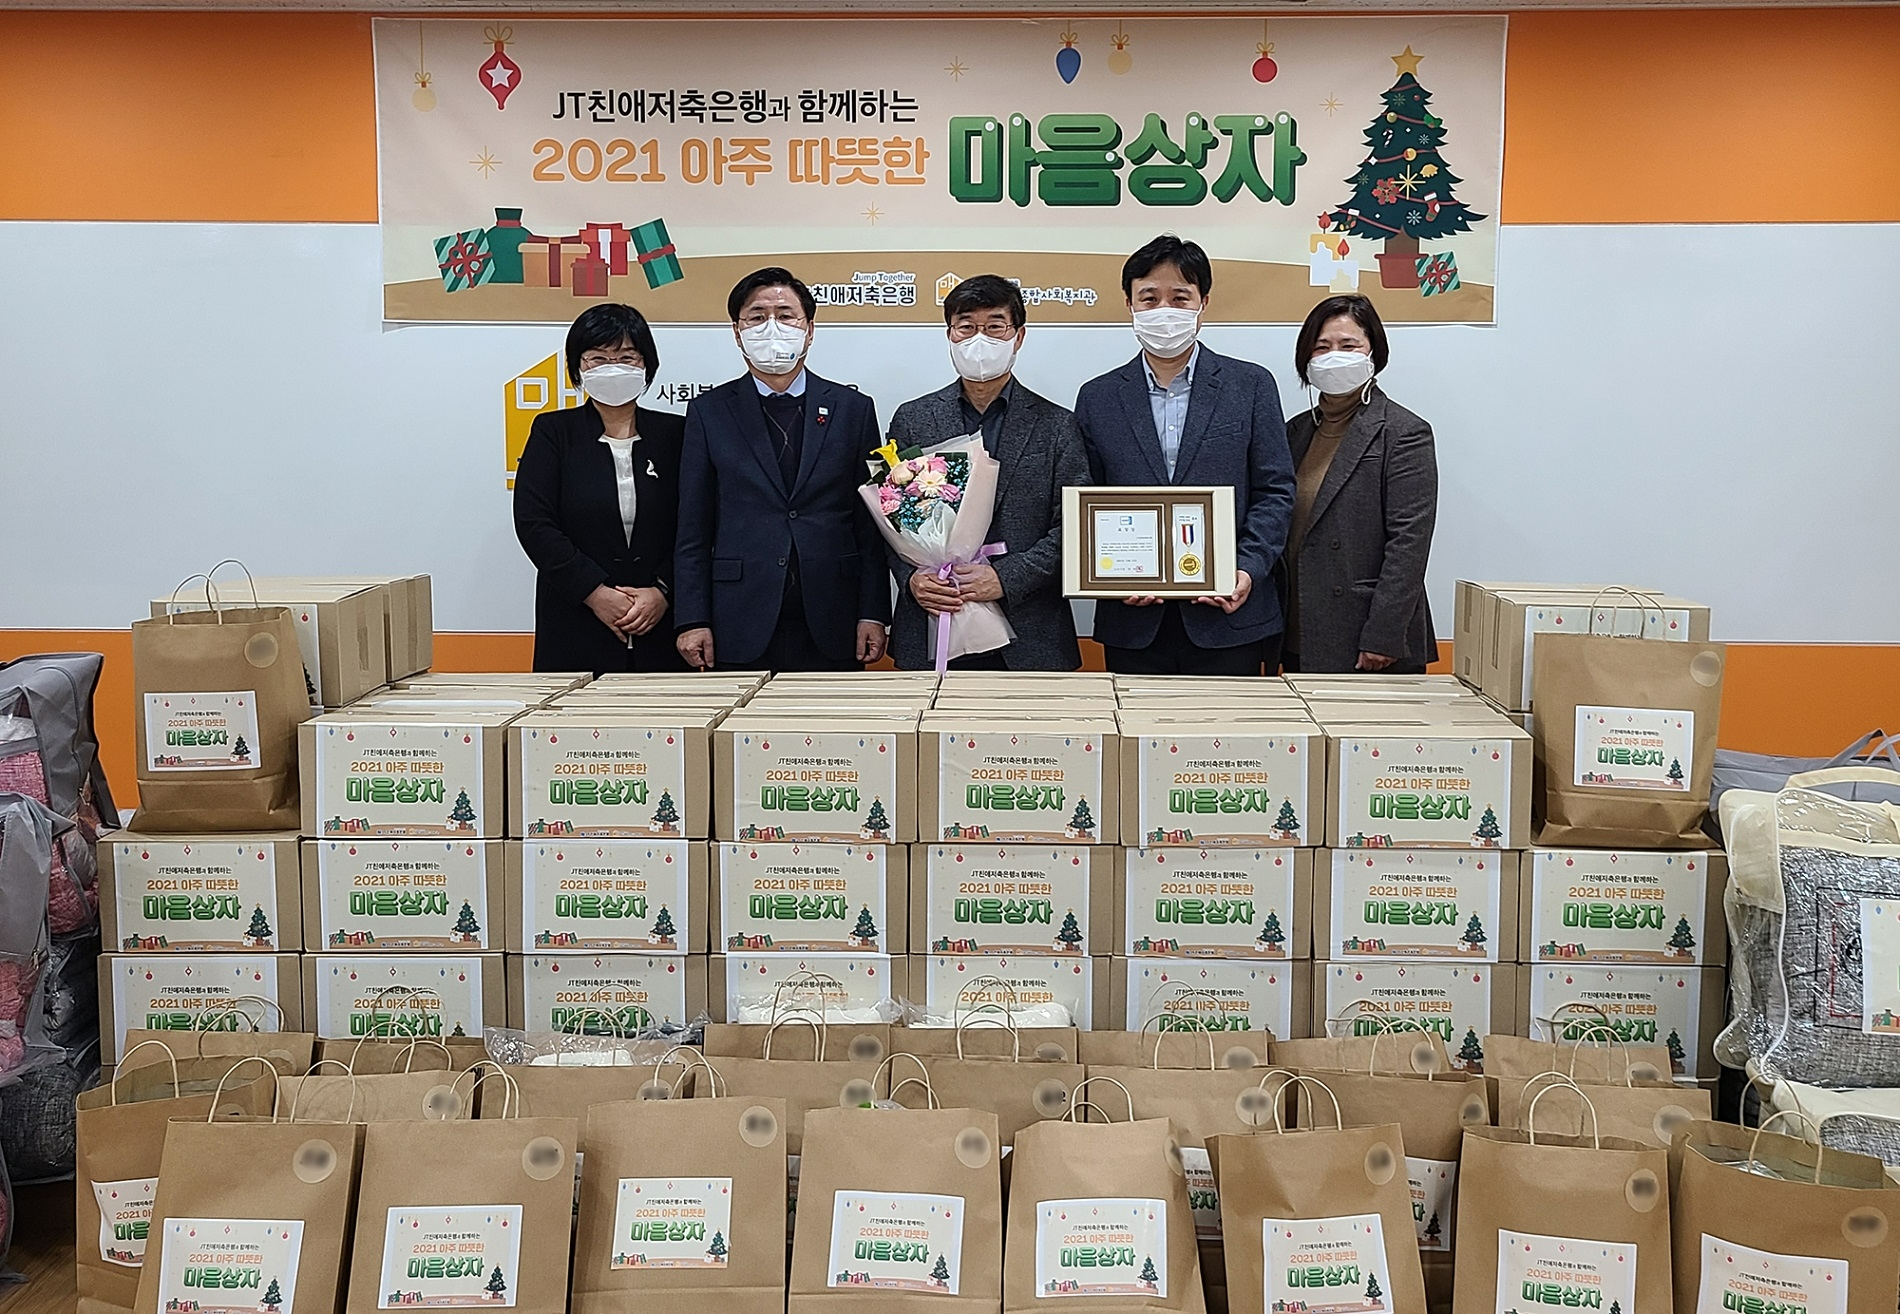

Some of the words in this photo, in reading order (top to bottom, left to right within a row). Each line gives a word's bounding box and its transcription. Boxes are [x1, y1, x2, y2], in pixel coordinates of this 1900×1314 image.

[552, 89, 791, 124] JT친애저축은행과
[798, 89, 919, 124] 함께하는
[532, 137, 666, 184] 2021
[681, 137, 773, 185] 아주
[788, 136, 930, 186] 따뜻한
[949, 112, 1307, 207] 마음상자
[854, 273, 877, 283] Jump
[878, 273, 914, 283] Together
[813, 285, 914, 305] 친애저축은행
[1021, 289, 1096, 304] 종합사회복지관
[165, 728, 229, 746] 마음상자
[1601, 736, 1623, 745] 2021
[1597, 746, 1664, 767] 마음상자
[351, 761, 383, 773] 2021
[386, 762, 407, 773] 아주
[411, 762, 444, 774] 따뜻한
[554, 764, 586, 775] 2021
[589, 764, 611, 775] 아주
[614, 763, 647, 775] 따뜻한
[766, 770, 798, 781] 2021
[801, 770, 822, 782] 아주
[826, 771, 859, 783] 따뜻한
[971, 768, 1003, 780] 2021
[1006, 769, 1028, 781] 아주
[1031, 769, 1065, 782] 따뜻한
[1174, 773, 1206, 784] 2021
[1209, 773, 1231, 784] 아주
[1235, 772, 1268, 784] 따뜻한
[346, 776, 446, 804] 마음상자
[549, 778, 649, 805] 마음상자
[1375, 778, 1408, 789] 2021
[1411, 778, 1433, 790] 아주
[1436, 778, 1471, 791] 따뜻한
[761, 784, 860, 813] 마음상자
[966, 783, 1065, 812] 마음상자
[1169, 787, 1269, 814] 마음상자
[1369, 792, 1472, 821] 마음상자
[147, 879, 179, 890] 2021
[181, 879, 203, 891] 아주
[206, 879, 239, 891] 따뜻한
[354, 875, 386, 886] 2021
[388, 875, 410, 886] 아주
[414, 875, 447, 886] 따뜻한
[560, 879, 590, 890] 2021
[592, 880, 613, 891] 아주
[616, 880, 647, 892] 따뜻한
[754, 879, 786, 890] 2021
[789, 879, 810, 891] 아주
[814, 879, 847, 891] 따뜻한
[959, 882, 991, 894] 2021
[994, 883, 1016, 895] 아주
[1019, 883, 1052, 895] 따뜻한
[1161, 883, 1193, 894] 2021
[1195, 883, 1217, 895] 아주
[1221, 884, 1254, 896] 따뜻한
[1369, 885, 1399, 897] 2021
[1402, 886, 1423, 897] 아주
[1426, 887, 1458, 898] 따뜻한
[1569, 886, 1602, 898] 2021
[1604, 887, 1627, 899] 아주
[1630, 888, 1665, 901] 따뜻한
[142, 894, 242, 920] 마음상자
[349, 890, 449, 916] 마음상자
[555, 893, 648, 919] 마음상자
[749, 893, 848, 920] 마음상자
[954, 897, 1053, 925] 마음상자
[1155, 897, 1255, 925] 마음상자
[1364, 899, 1458, 926] 마음상자
[1562, 901, 1666, 931] 마음상자
[150, 998, 180, 1008] 2021
[182, 998, 203, 1009] 아주
[354, 998, 384, 1009] 2021
[556, 992, 588, 1003] 2021
[1394, 1001, 1416, 1013] 아주
[1419, 1001, 1453, 1013] 따뜻한
[1625, 1004, 1657, 1016] 따뜻한
[116, 1210, 141, 1220] 2021
[636, 1209, 660, 1218] 2021
[630, 1220, 706, 1241] 마음상자
[860, 1227, 884, 1237] 2021
[1064, 1235, 1088, 1244] 2021
[413, 1244, 438, 1253] 2021
[854, 1238, 930, 1264] 마음상자
[189, 1254, 215, 1263] 2021
[1060, 1246, 1136, 1267] 마음상자
[1290, 1254, 1315, 1264] 2021
[406, 1255, 485, 1278] 마음상자
[182, 1265, 263, 1290] 마음상자
[1287, 1263, 1361, 1289] 마음상자
[1527, 1268, 1553, 1280] 2021
[1728, 1279, 1755, 1293] 2021
[1522, 1279, 1603, 1310] 마음상자
